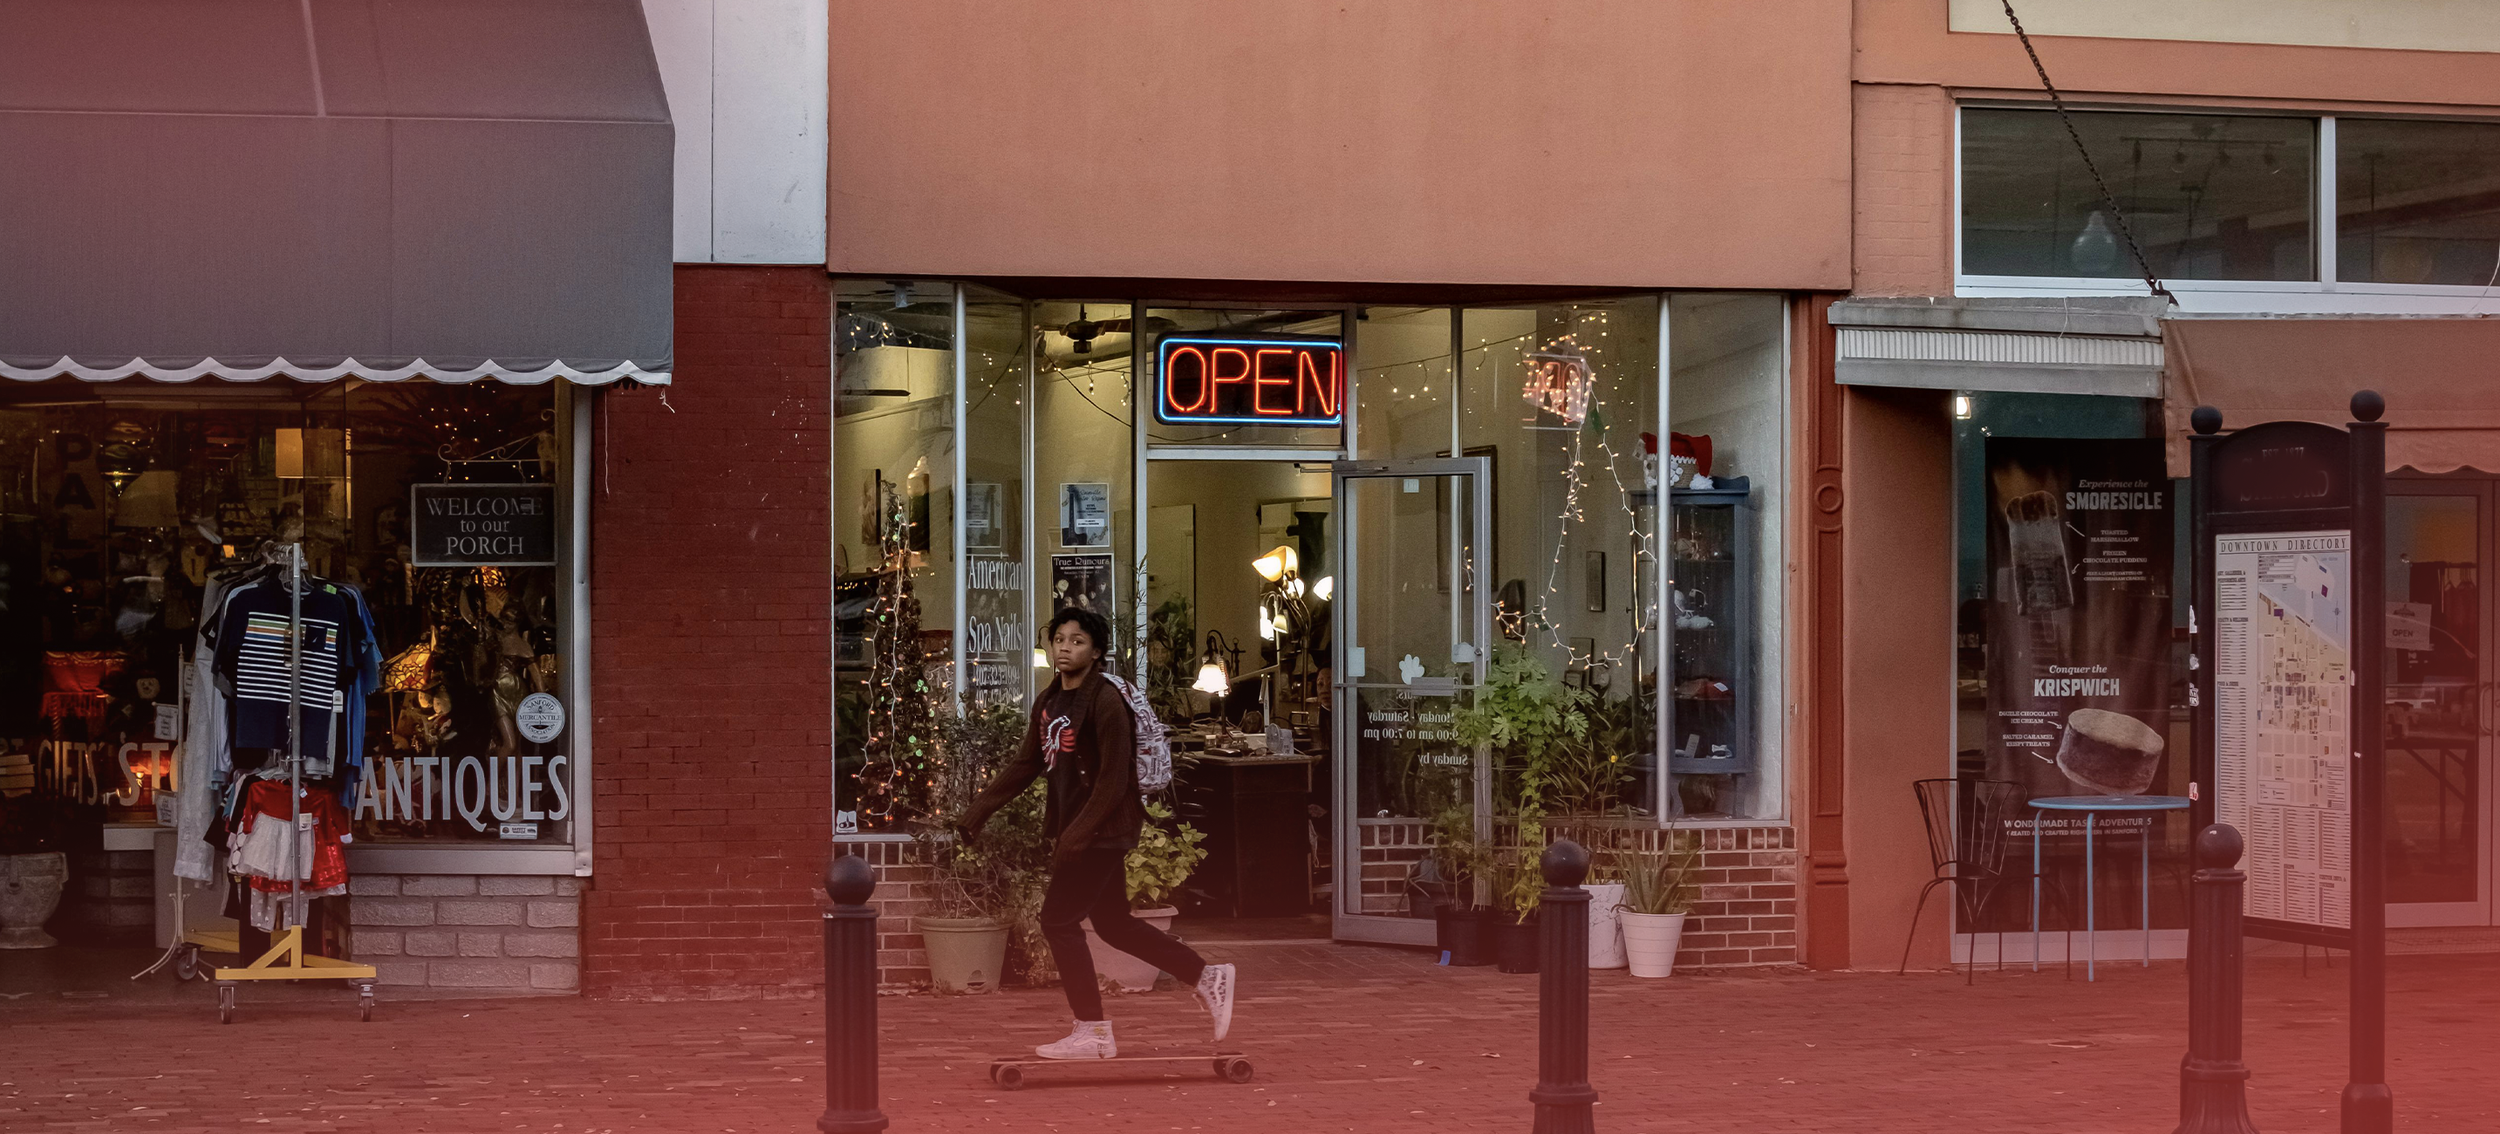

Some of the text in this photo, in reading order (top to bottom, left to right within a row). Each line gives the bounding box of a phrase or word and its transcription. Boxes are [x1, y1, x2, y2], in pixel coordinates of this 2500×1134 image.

[1166, 346, 1336, 415] OPEN
[2078, 479, 2149, 490] Experience the
[425, 497, 544, 516] WELCOME
[2065, 491, 2163, 510] SMORESICLE
[460, 519, 510, 533] to our
[445, 536, 524, 556] PORCH
[2221, 538, 2347, 553] DOWNTOWN DIRECTORY
[1053, 557, 1072, 566] True
[968, 553, 1023, 591] American
[968, 613, 1023, 661] Spa Nails
[2392, 628, 2414, 638] OPEN
[2049, 664, 2108, 675] Conquer the
[2033, 678, 2120, 697] KRISPWICH
[38, 739, 98, 806] GIFTS
[354, 755, 569, 833] ANTIQUES
[2003, 817, 2152, 828] WONDRMADE TASE ADVENTURS
